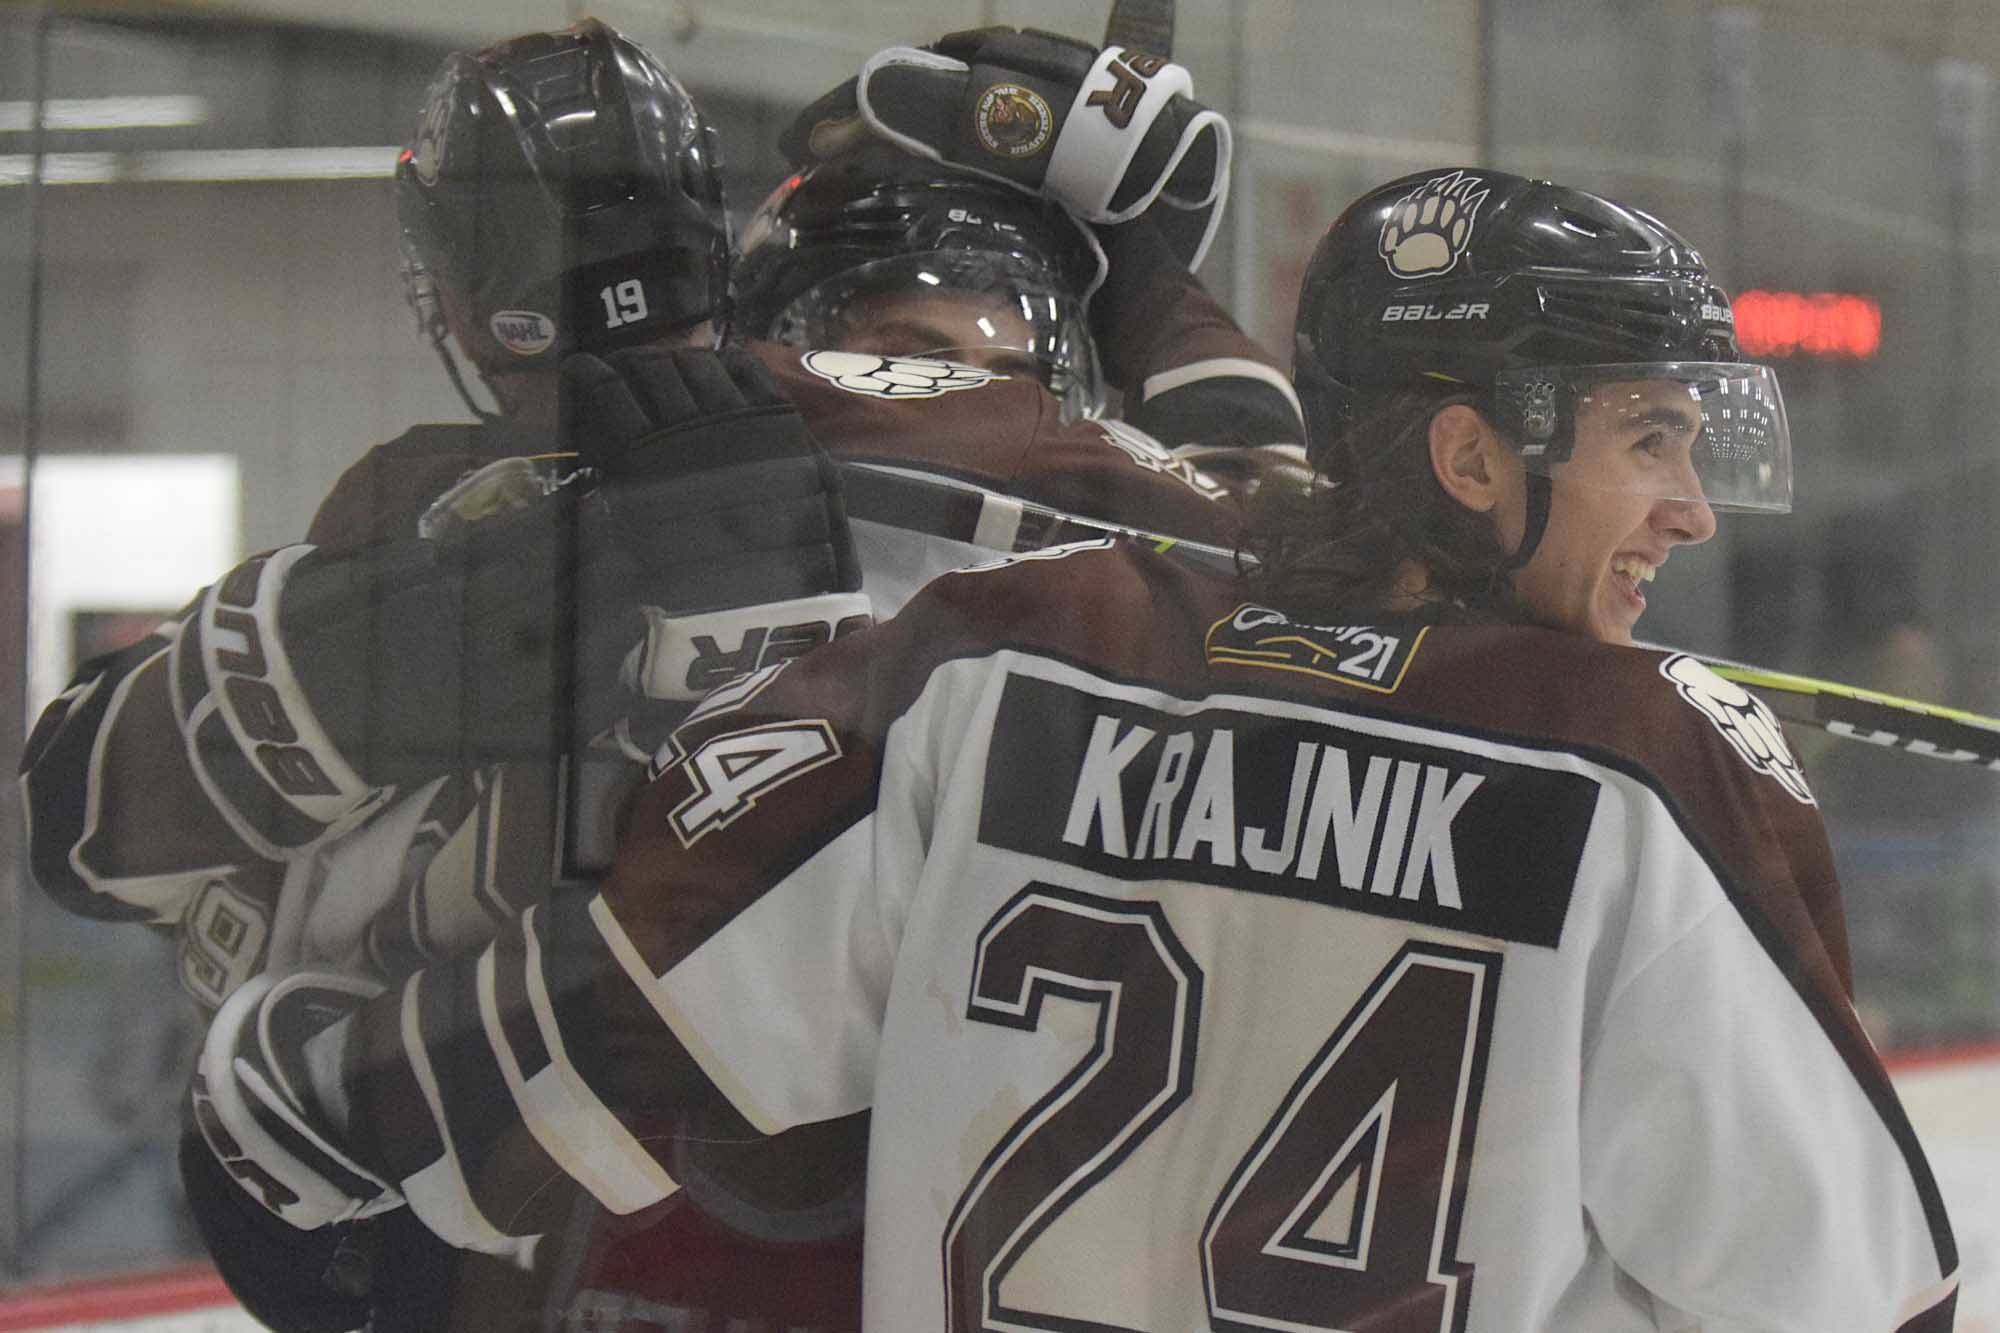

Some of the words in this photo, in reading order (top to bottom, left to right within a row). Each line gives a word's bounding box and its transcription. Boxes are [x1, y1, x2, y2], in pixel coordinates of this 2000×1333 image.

[599, 279, 649, 330] 19
[1337, 633, 1400, 681] 21
[1062, 715, 1486, 911] KRAJNIK
[942, 880, 1506, 1332] 24
